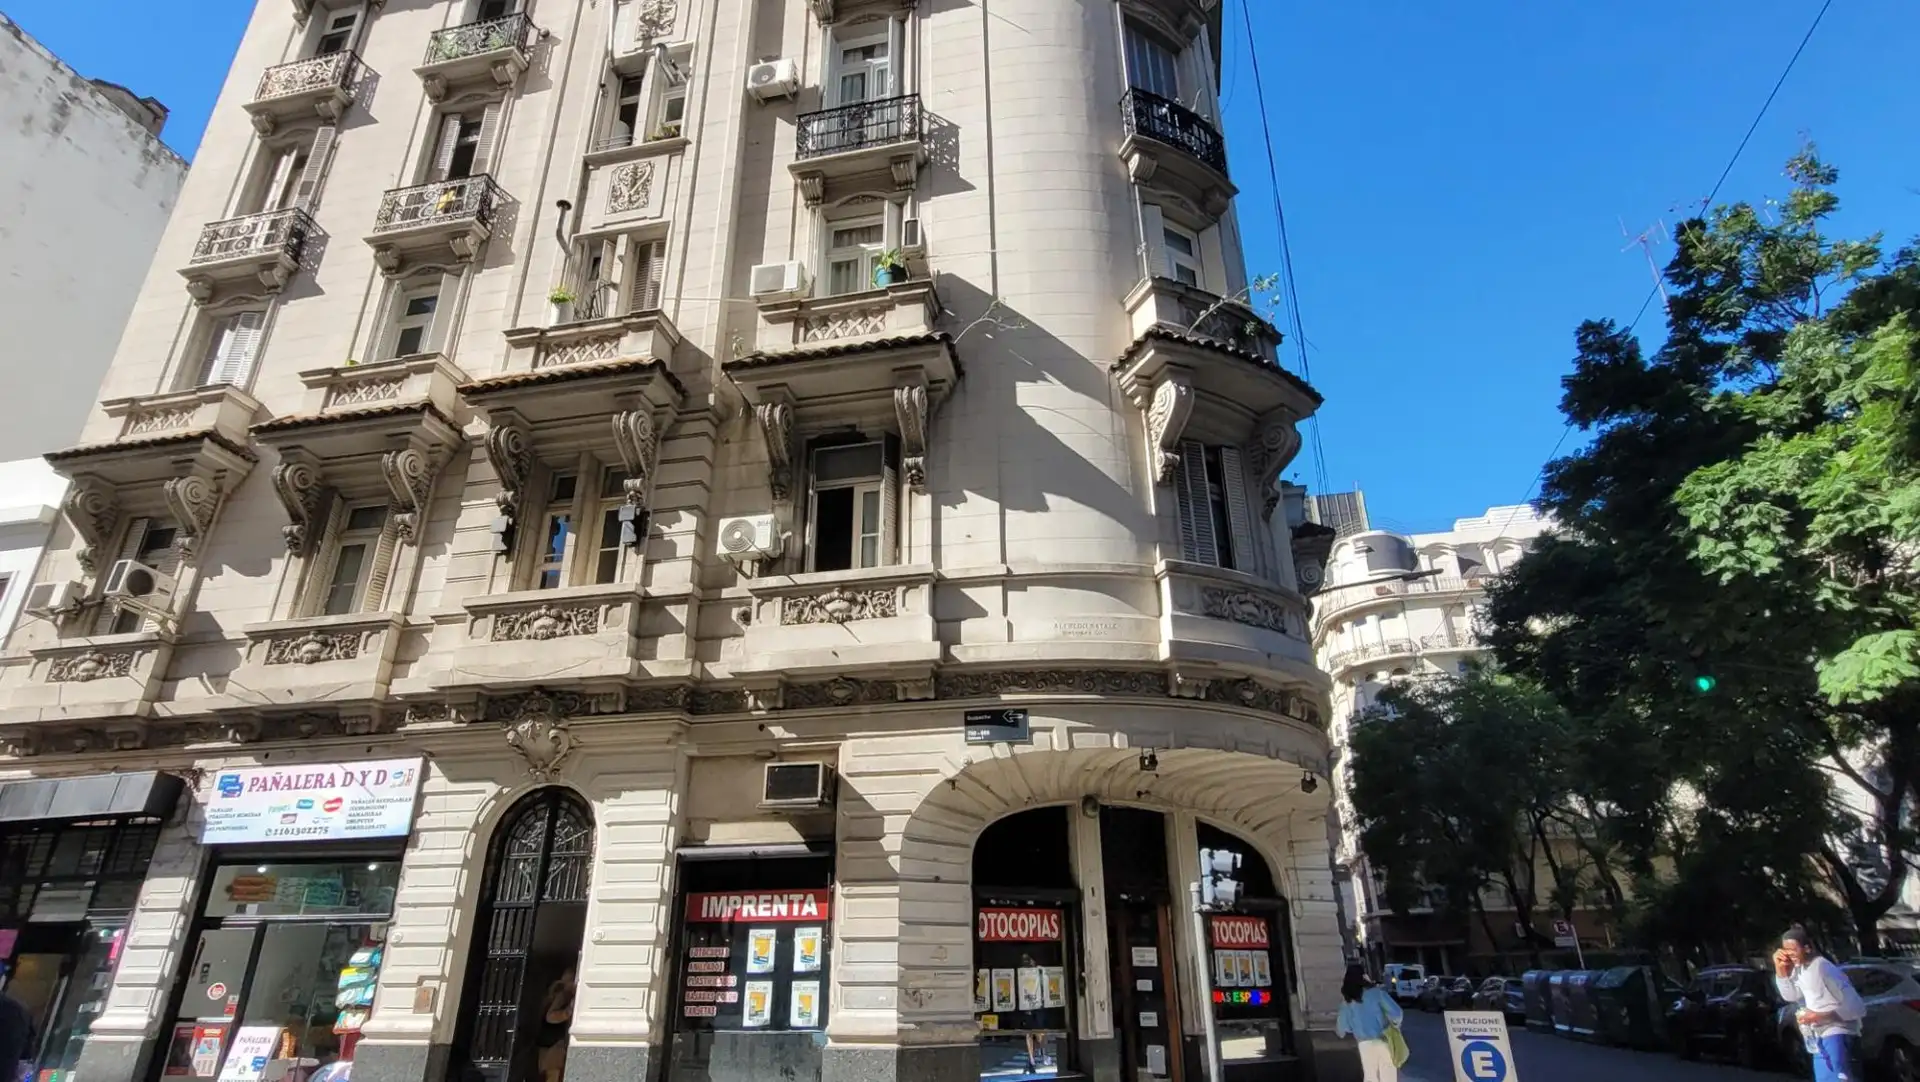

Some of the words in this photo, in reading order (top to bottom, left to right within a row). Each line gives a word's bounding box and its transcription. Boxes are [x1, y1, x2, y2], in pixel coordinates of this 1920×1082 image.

[247, 772, 336, 792] PAÑALERA
[341, 771, 354, 787] D
[360, 770, 372, 787] Y
[373, 769, 387, 786] D
[702, 894, 818, 918] IMPRENTA
[1450, 1017, 1501, 1025] ESTACIONE
[1471, 1050, 1498, 1077] E
